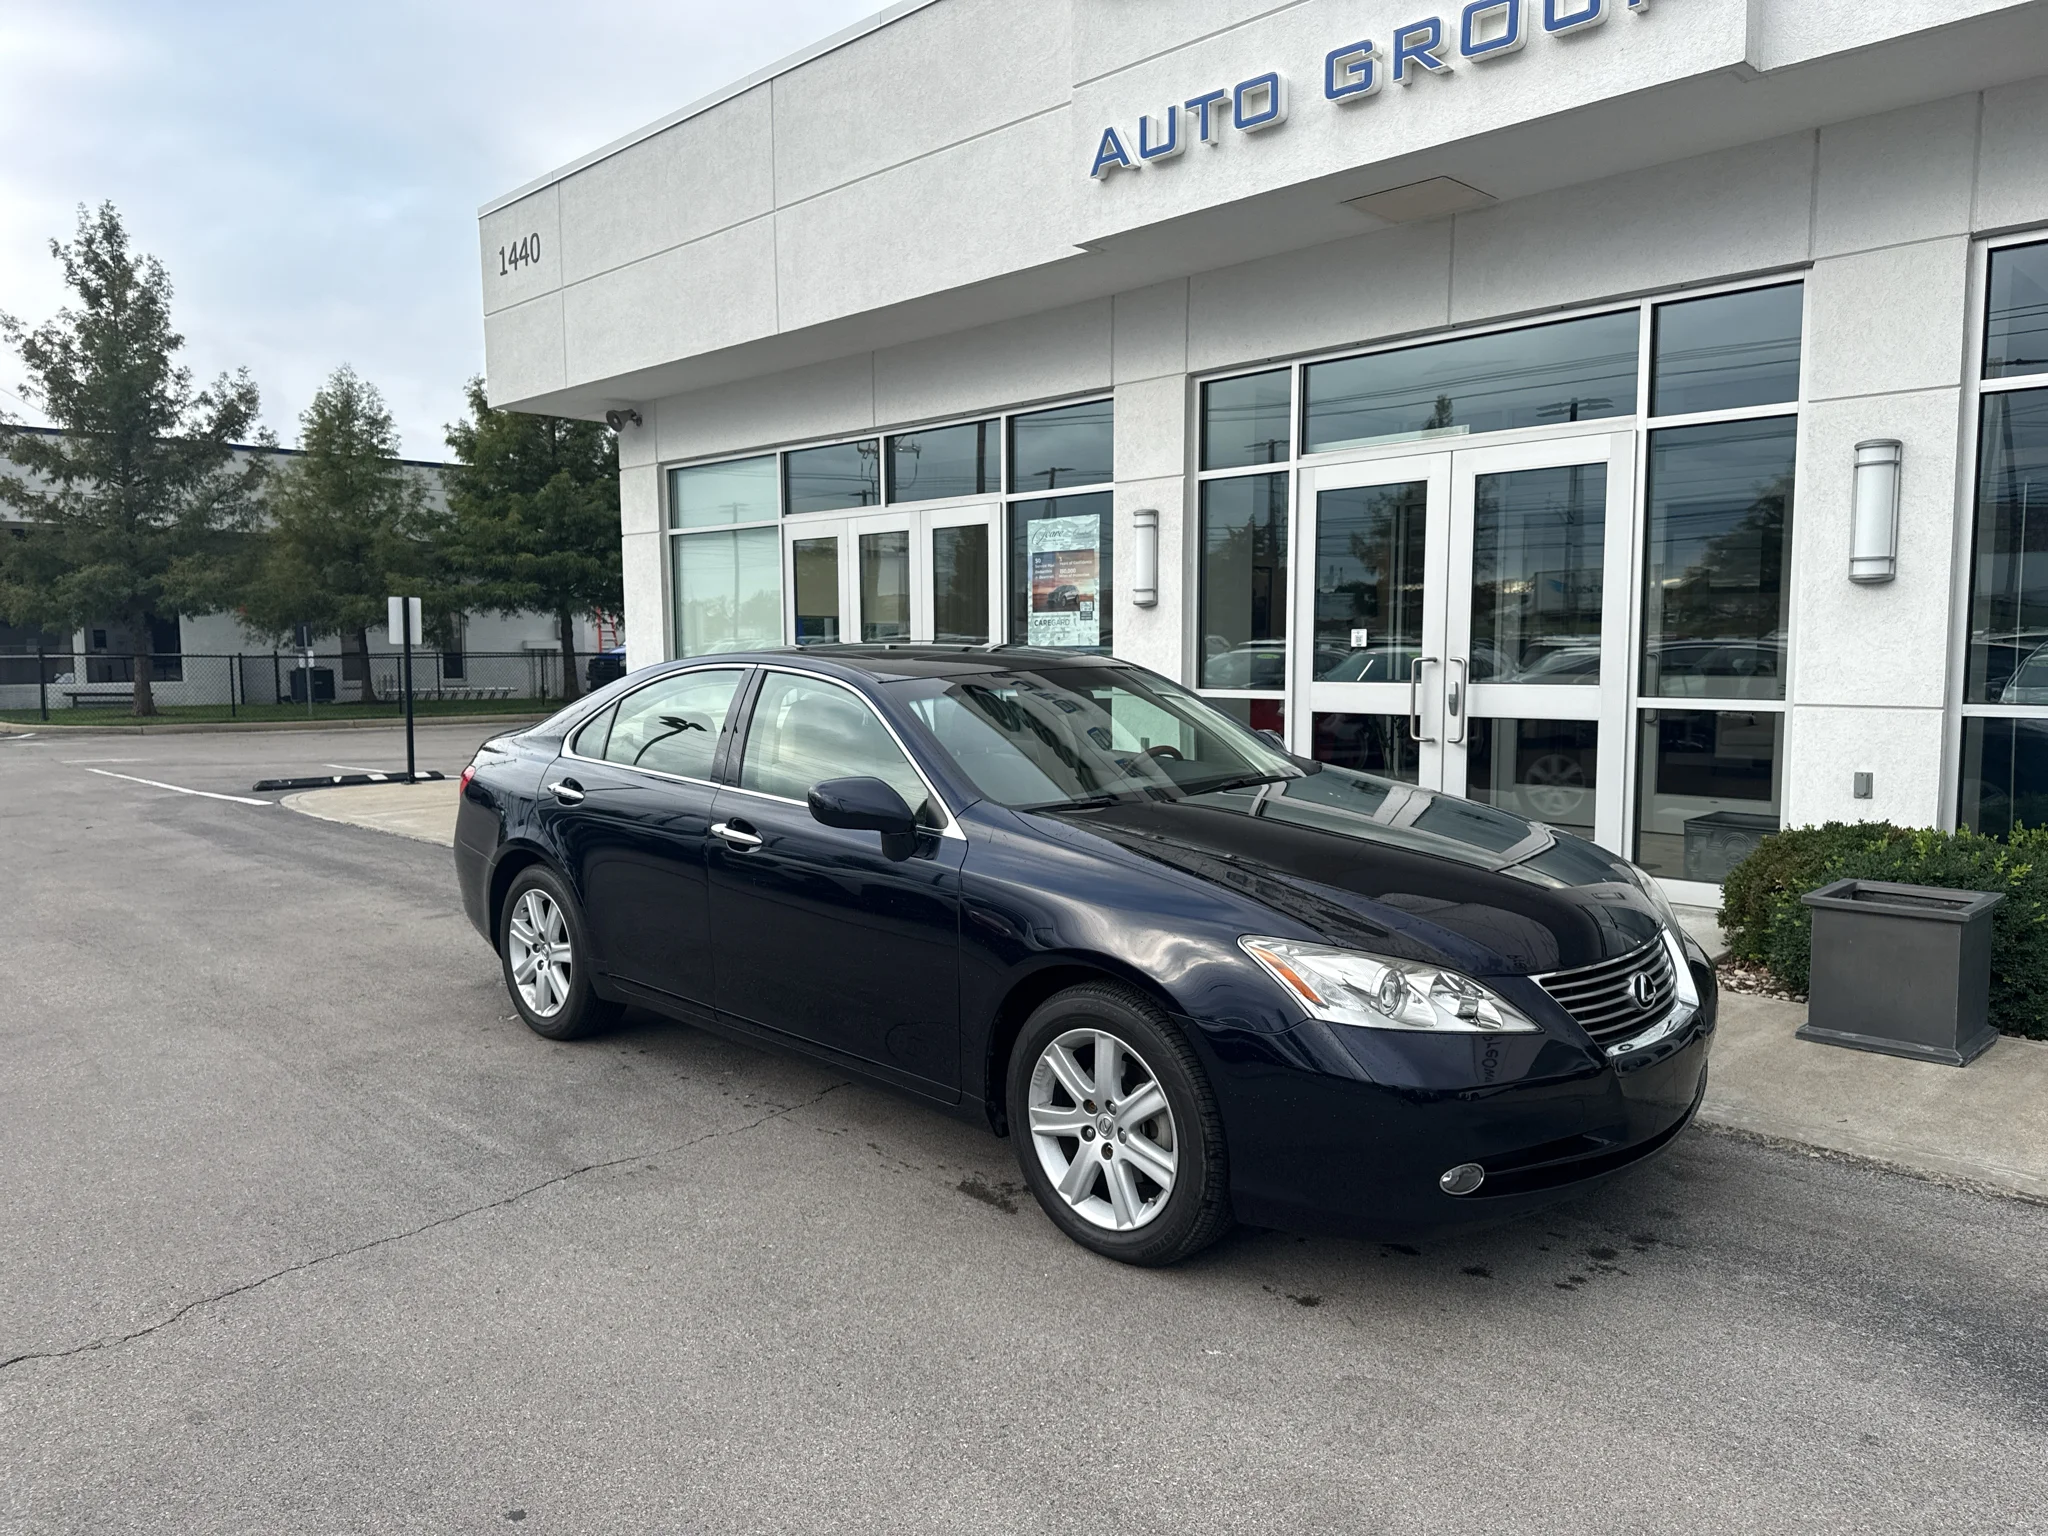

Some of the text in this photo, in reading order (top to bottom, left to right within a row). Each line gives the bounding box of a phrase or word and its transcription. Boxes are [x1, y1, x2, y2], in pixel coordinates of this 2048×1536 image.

[1090, 0, 1649, 179] AUTO GROU
[499, 232, 540, 276] 1440
[1034, 618, 1070, 627] CAREGARD
